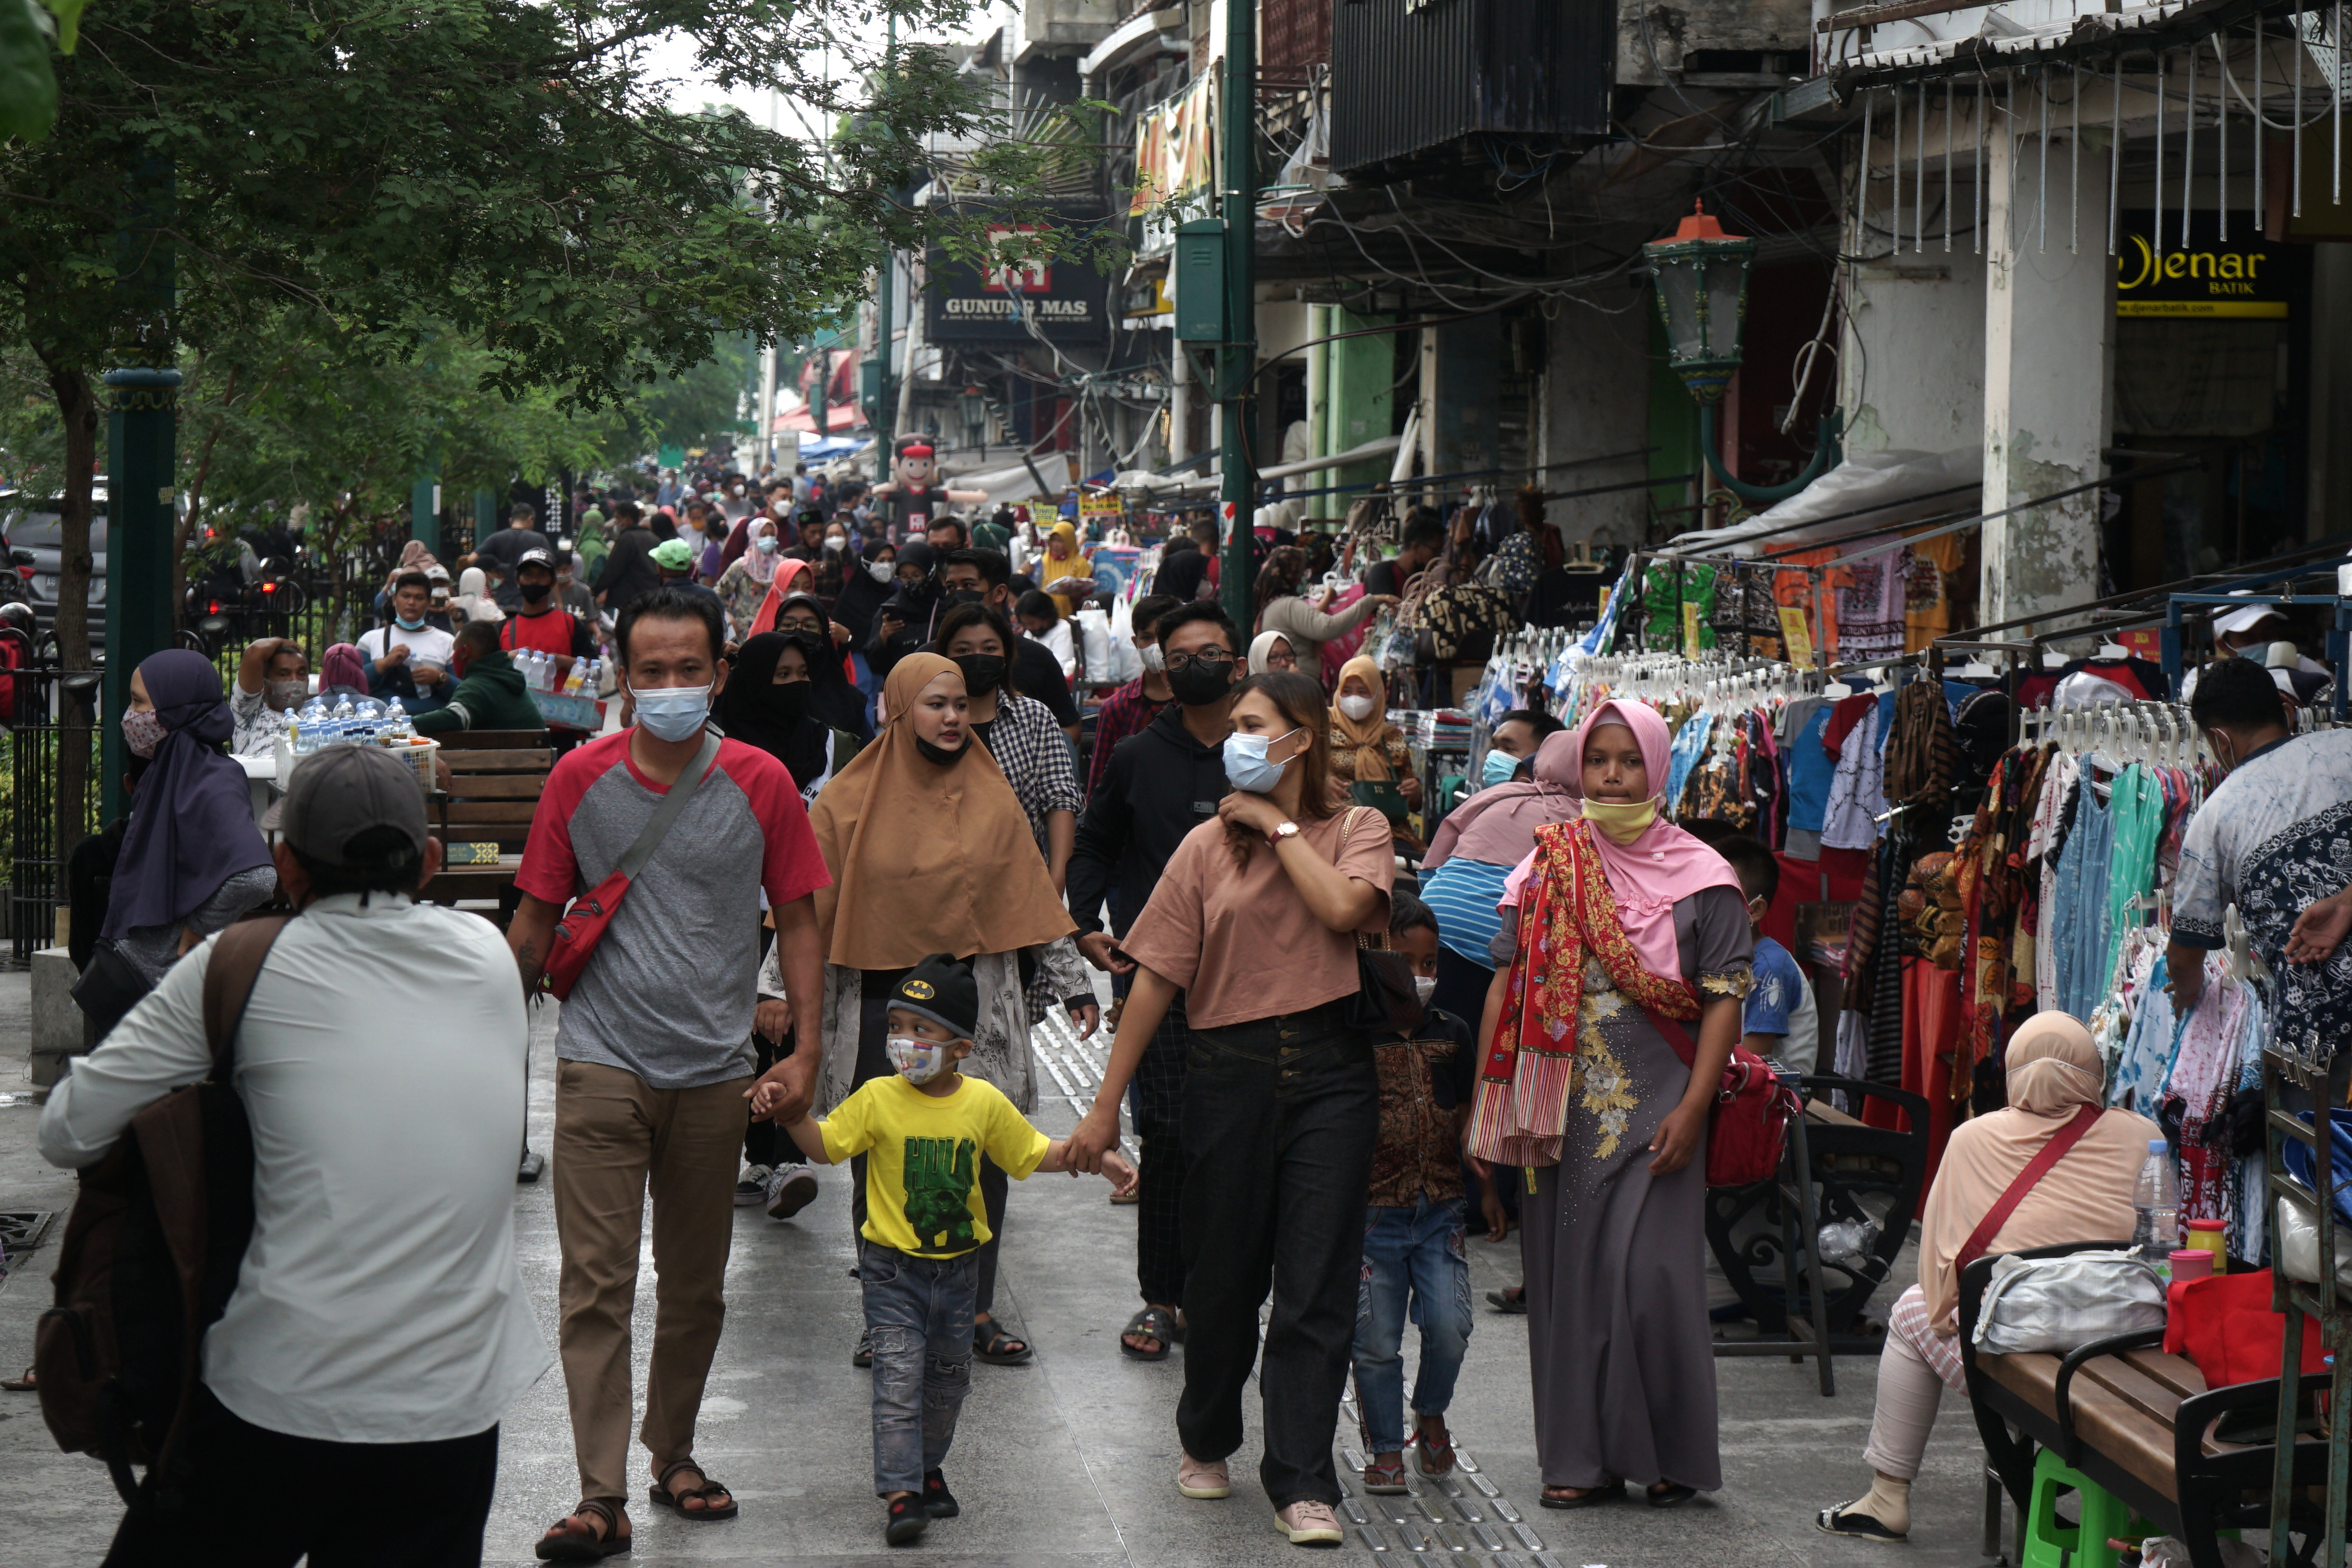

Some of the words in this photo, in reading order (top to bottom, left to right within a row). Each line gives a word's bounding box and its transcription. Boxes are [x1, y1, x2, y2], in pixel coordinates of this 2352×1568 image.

[2209, 281, 2256, 295] BATIK
[1042, 300, 1088, 316] MAS
[902, 1136, 976, 1191] HULK
